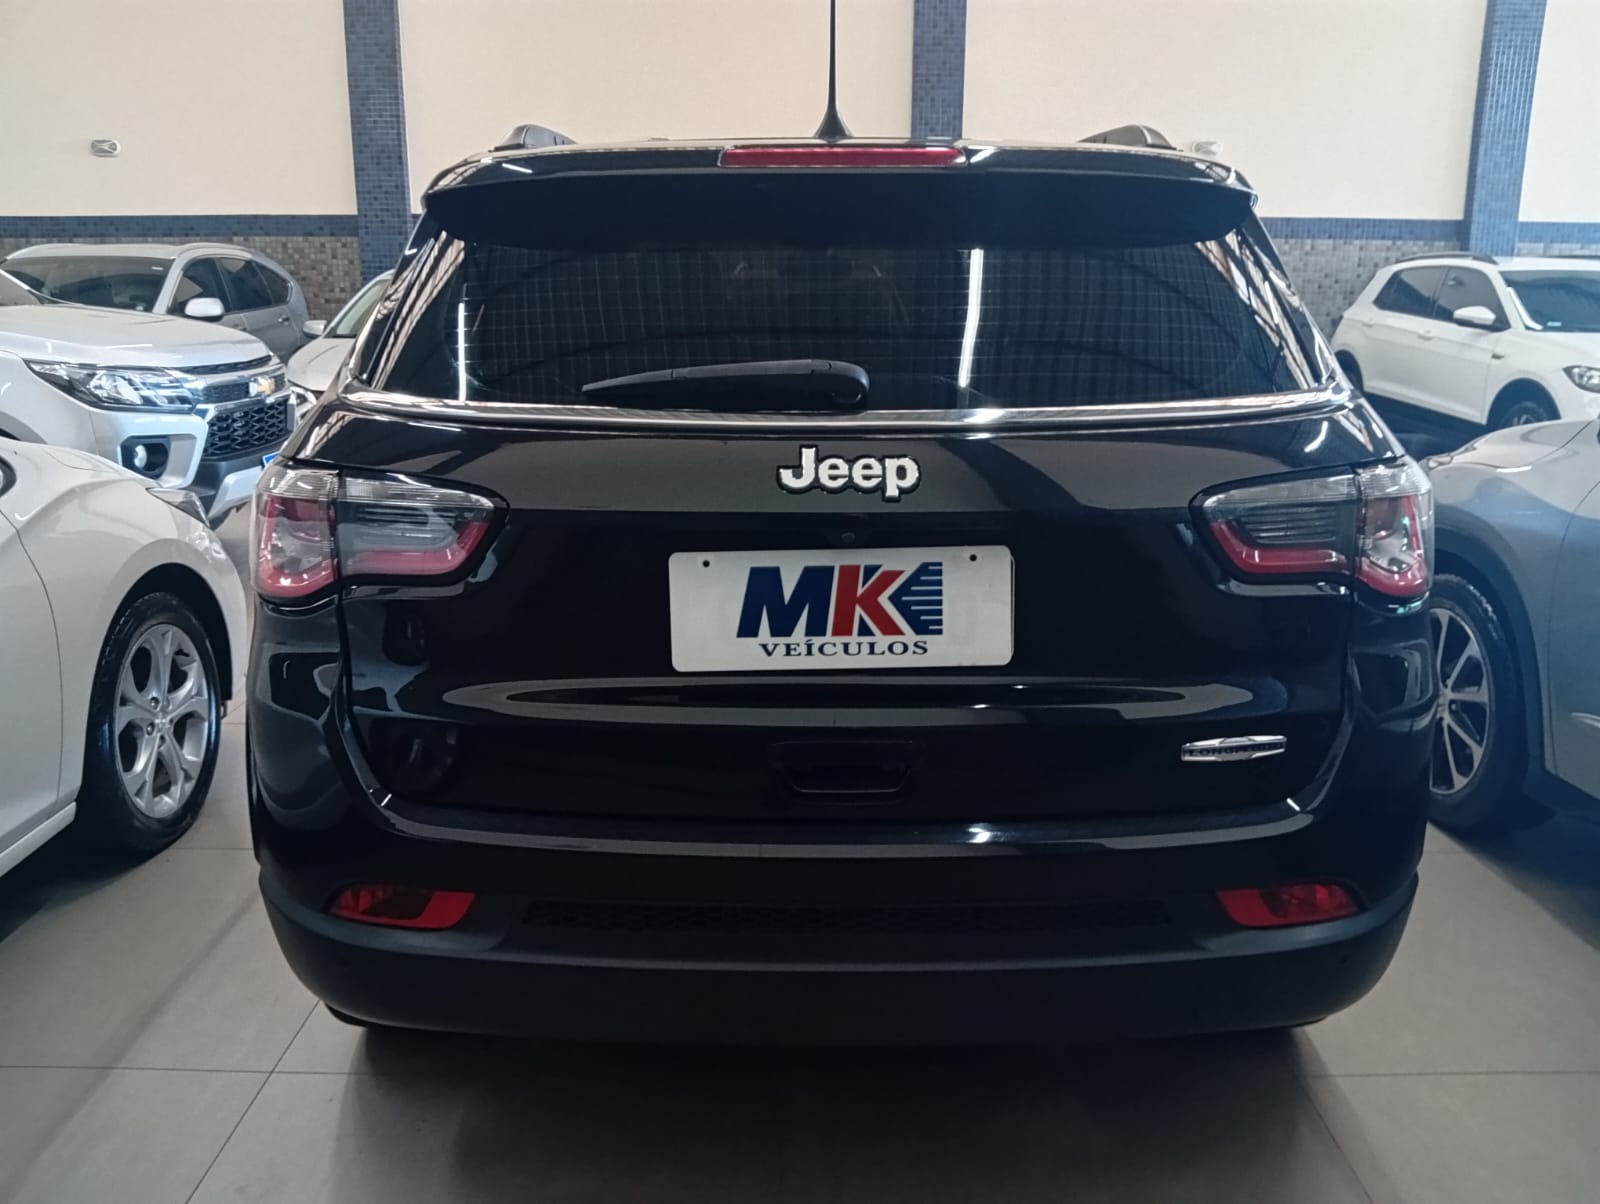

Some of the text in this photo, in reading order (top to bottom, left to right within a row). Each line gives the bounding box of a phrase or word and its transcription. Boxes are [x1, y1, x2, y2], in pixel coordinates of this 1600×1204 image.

[778, 446, 920, 501] Jeep
[735, 564, 907, 638] MK
[758, 639, 929, 657] VEÍCULOS
